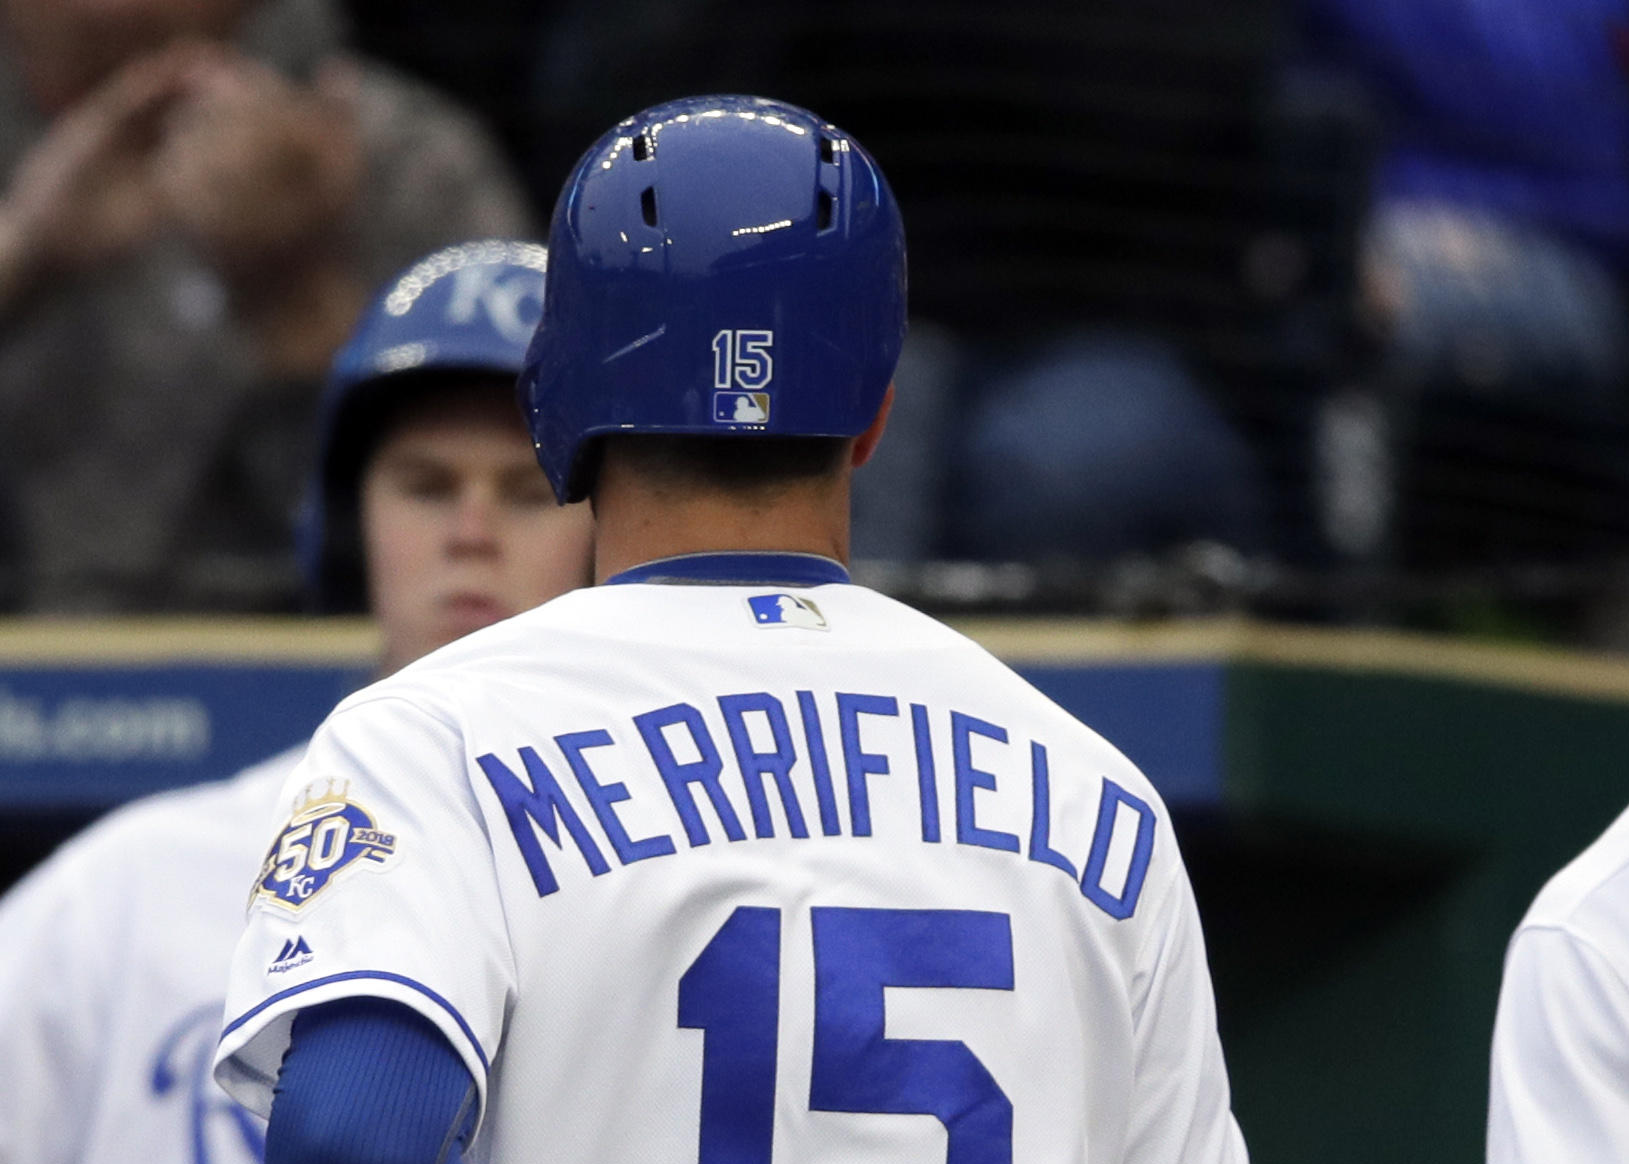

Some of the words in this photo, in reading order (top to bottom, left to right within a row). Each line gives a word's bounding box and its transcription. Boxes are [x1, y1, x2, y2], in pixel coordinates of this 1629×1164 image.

[712, 329, 774, 390] 15
[476, 690, 1157, 921] MERRIFIELD
[273, 815, 351, 883] 50
[355, 829, 396, 847] 2018
[285, 874, 316, 899] KC
